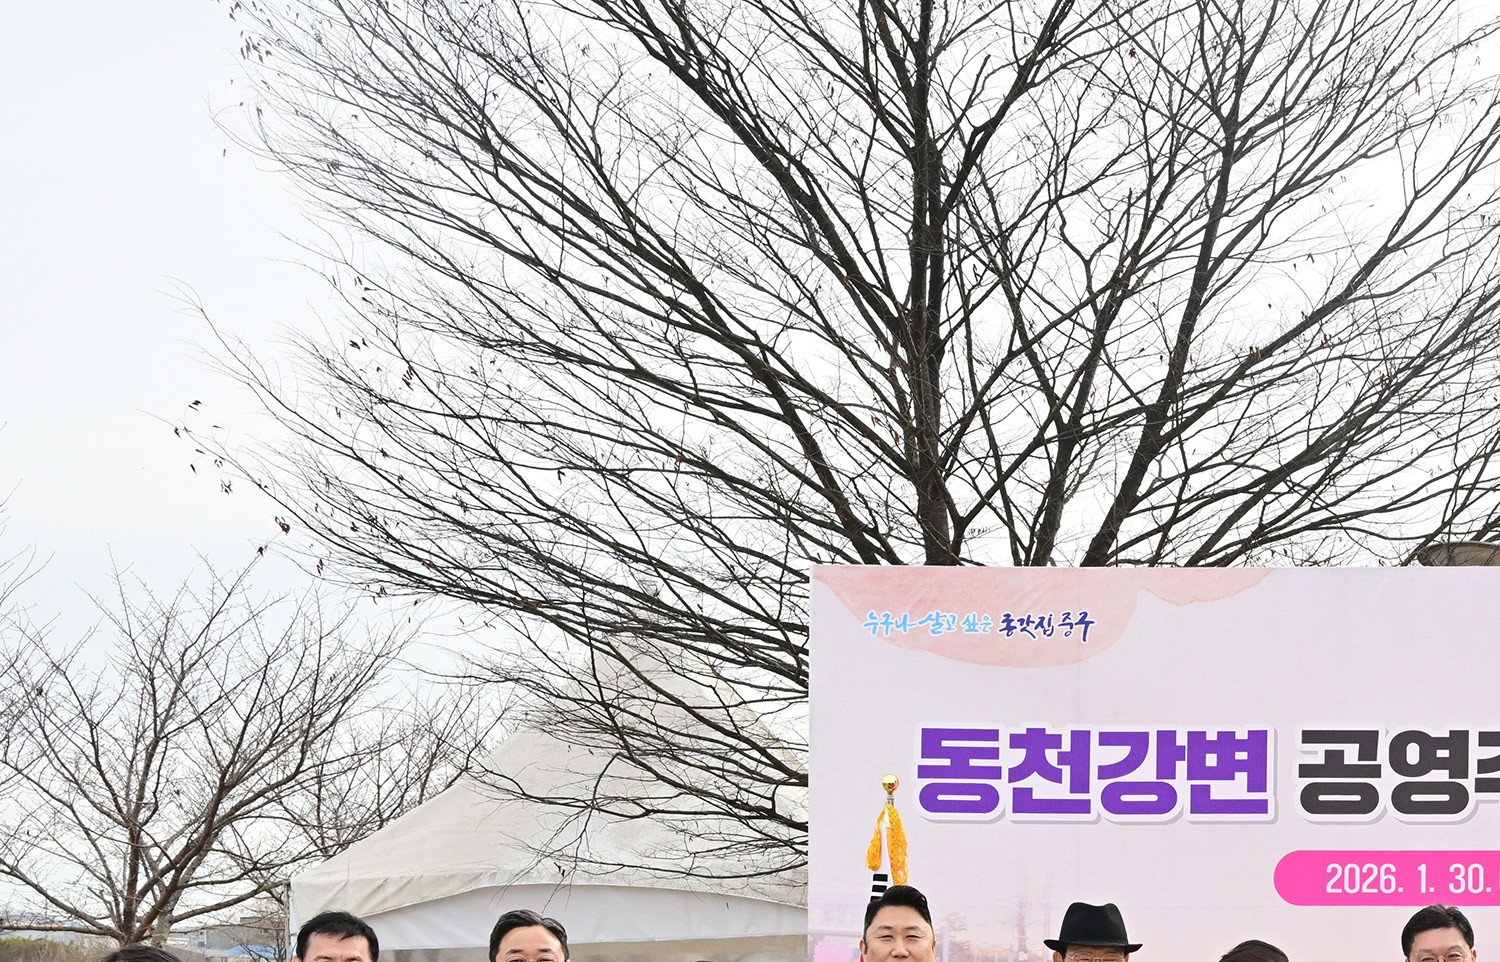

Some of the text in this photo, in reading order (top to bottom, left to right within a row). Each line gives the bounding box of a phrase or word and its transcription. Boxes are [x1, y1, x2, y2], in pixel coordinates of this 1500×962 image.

[863, 611, 1096, 643] 누구나 살고 싶은 종갓집 중구
[917, 727, 1269, 815] 동천강변
[1326, 863, 1404, 894] 2026.
[1417, 863, 1435, 894] 1.
